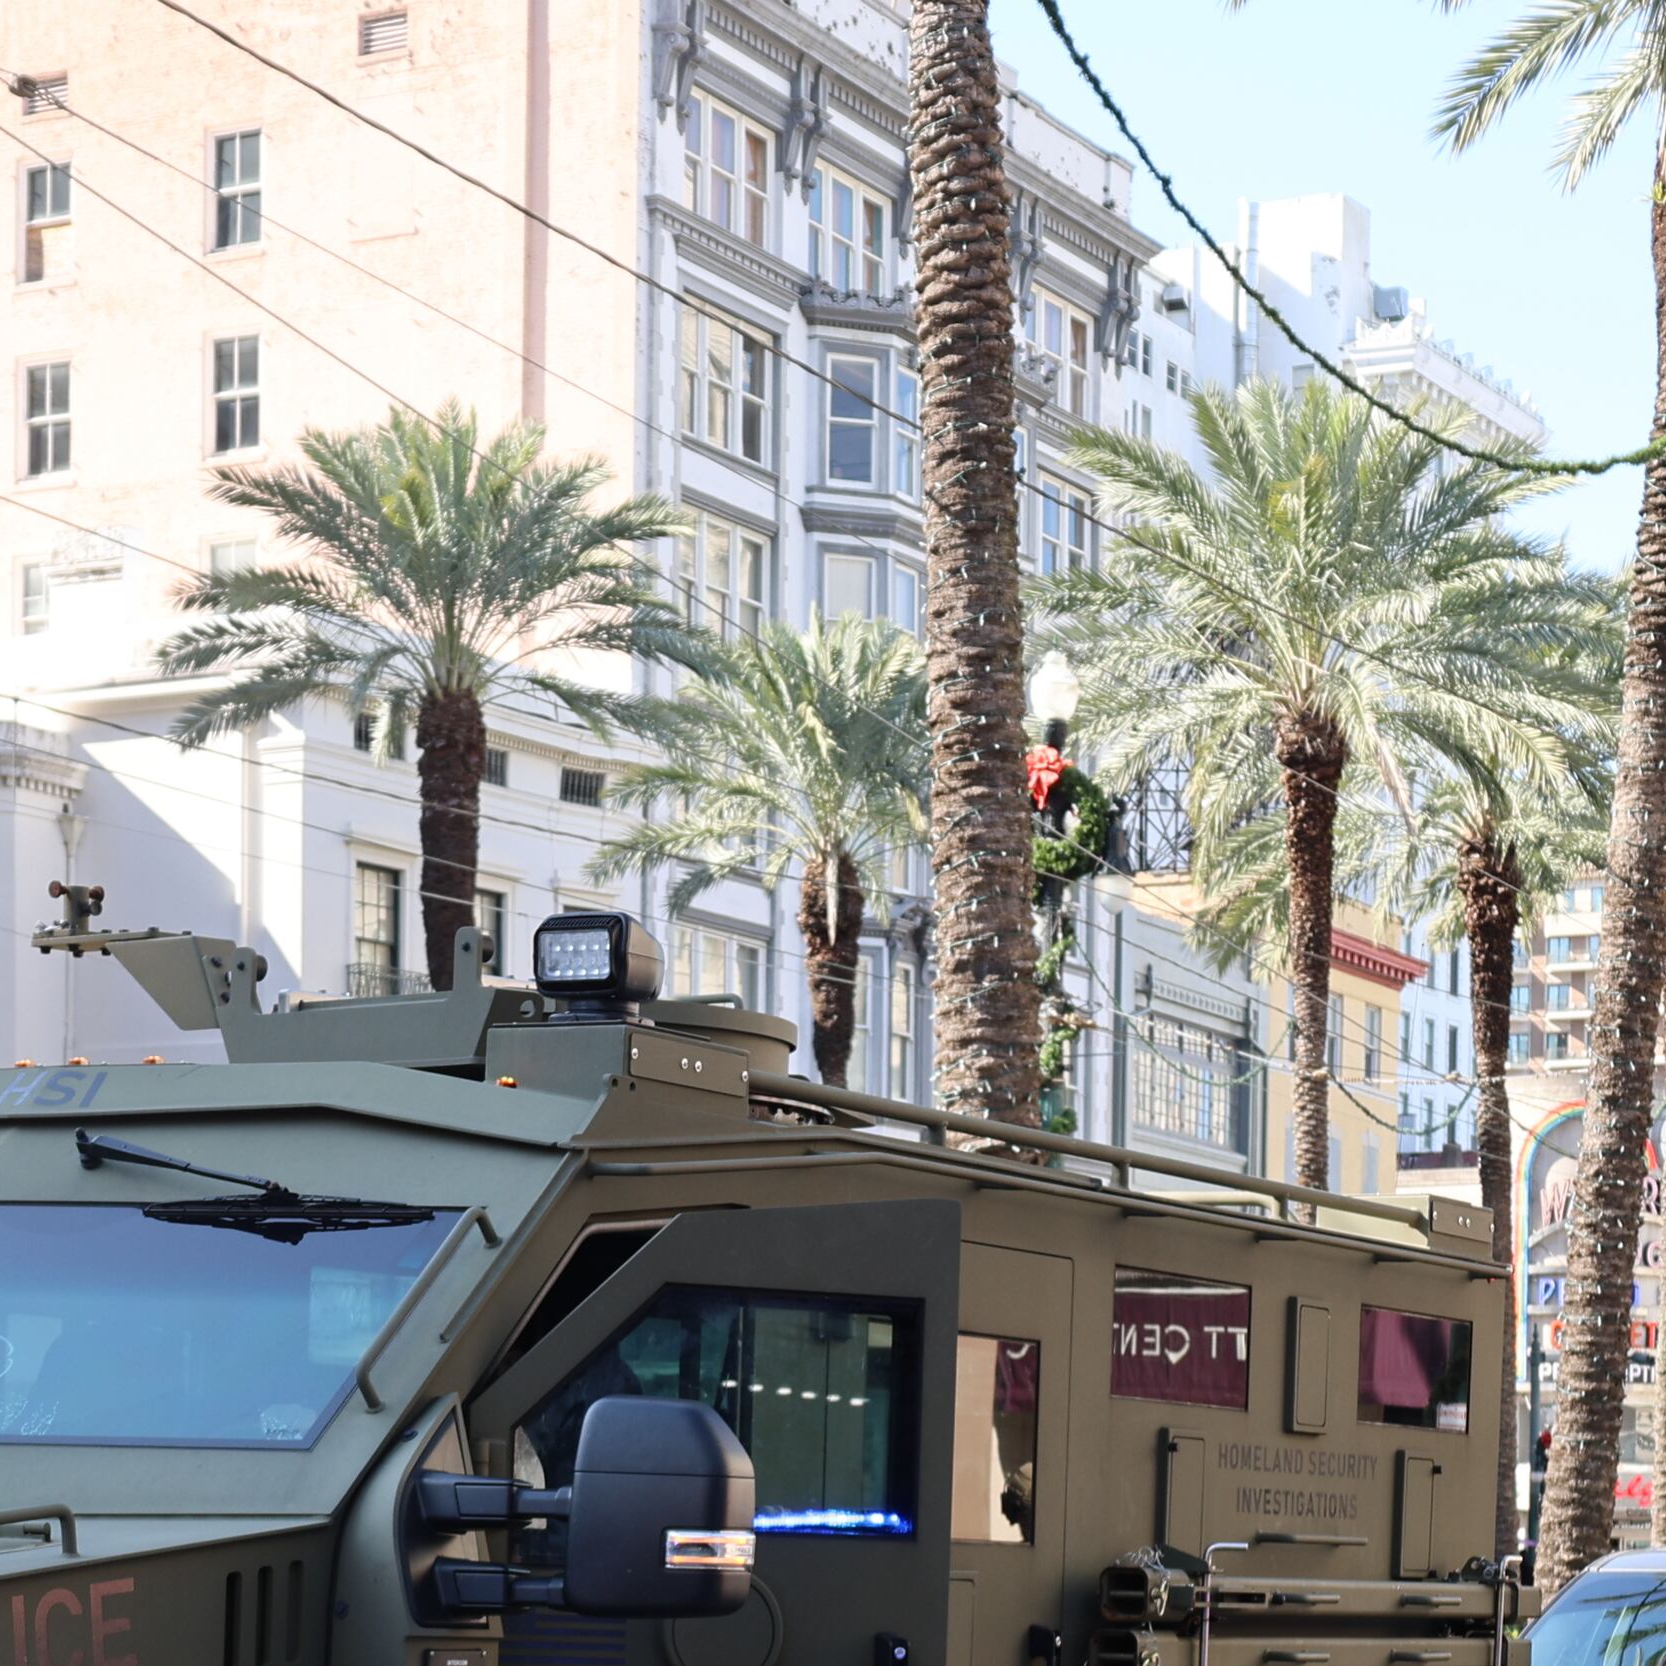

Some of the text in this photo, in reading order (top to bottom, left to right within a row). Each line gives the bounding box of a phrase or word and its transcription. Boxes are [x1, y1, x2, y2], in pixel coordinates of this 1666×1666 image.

[1218, 1442, 1378, 1481] HOMELAND SECURITY
[1236, 1485, 1358, 1521] INVESTIGATIONS
